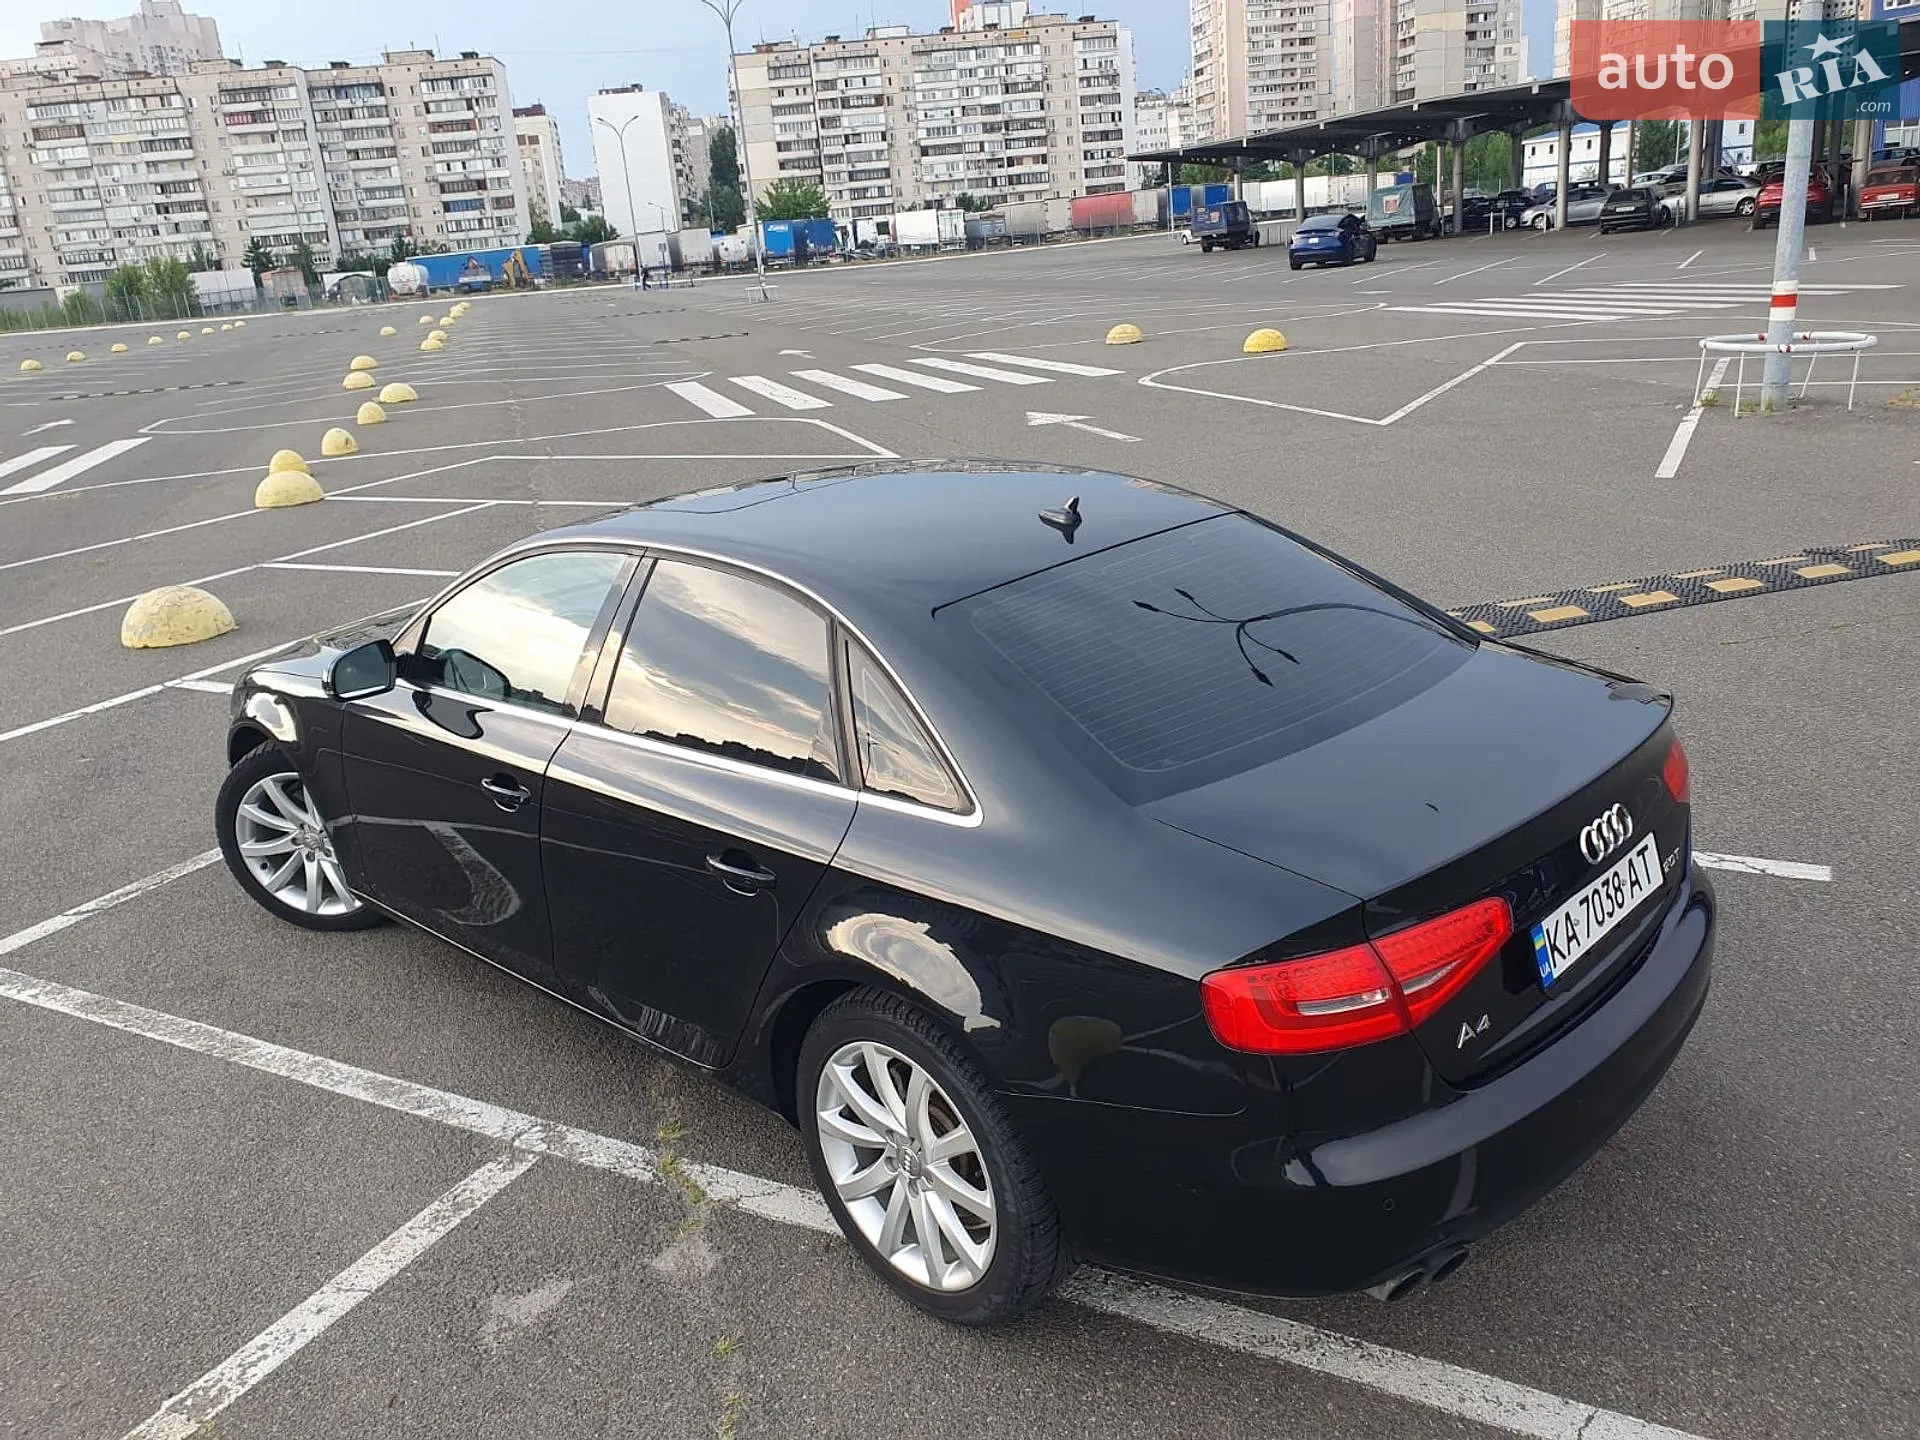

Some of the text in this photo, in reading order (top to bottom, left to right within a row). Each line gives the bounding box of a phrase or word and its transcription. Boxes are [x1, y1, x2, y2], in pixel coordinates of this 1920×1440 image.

[1545, 843, 1651, 969] KA 7038 AT
[1539, 961, 1552, 978] UA
[1457, 1014, 1490, 1049] A4
